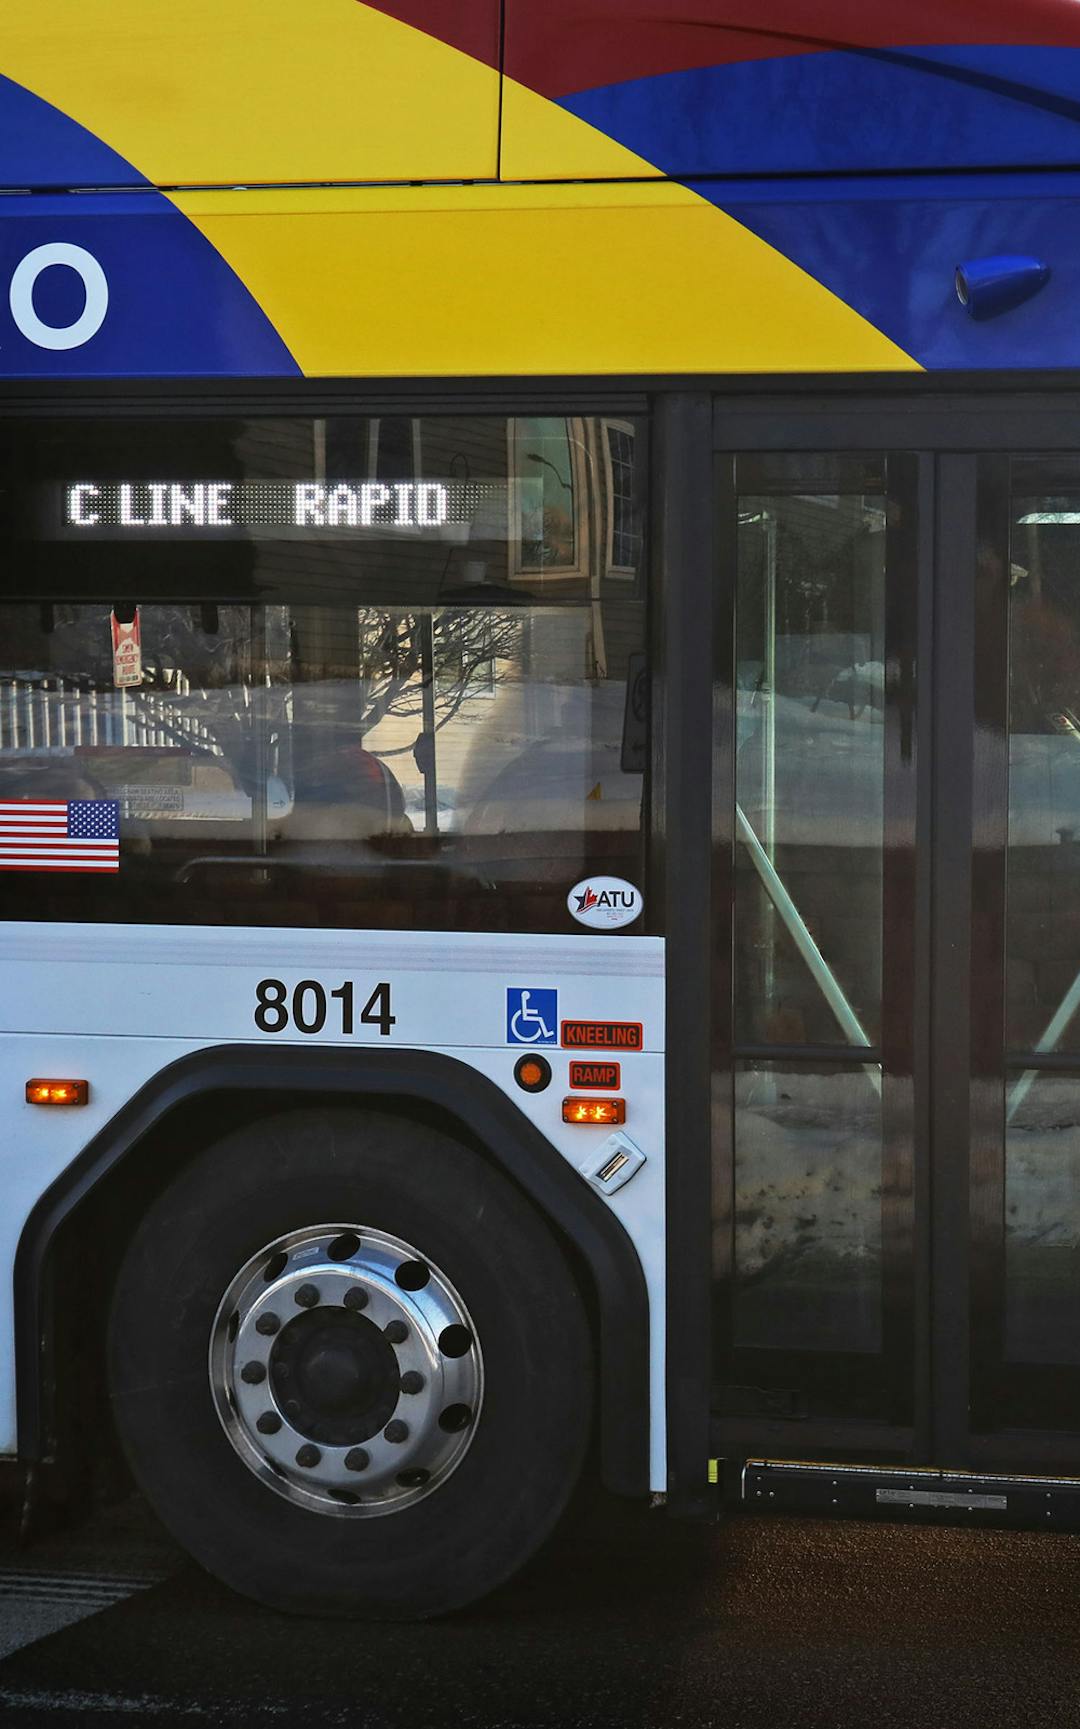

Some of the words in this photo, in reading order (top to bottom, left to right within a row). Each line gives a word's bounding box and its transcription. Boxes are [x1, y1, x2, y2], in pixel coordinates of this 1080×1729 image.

[8, 242, 109, 350] O
[69, 483, 99, 525] C
[120, 483, 232, 525] LINE
[295, 483, 448, 525] RAPID
[597, 890, 635, 908] ATU
[254, 978, 396, 1036] 8014
[565, 1026, 637, 1045] KNEELING
[573, 1067, 616, 1083] RAMP
